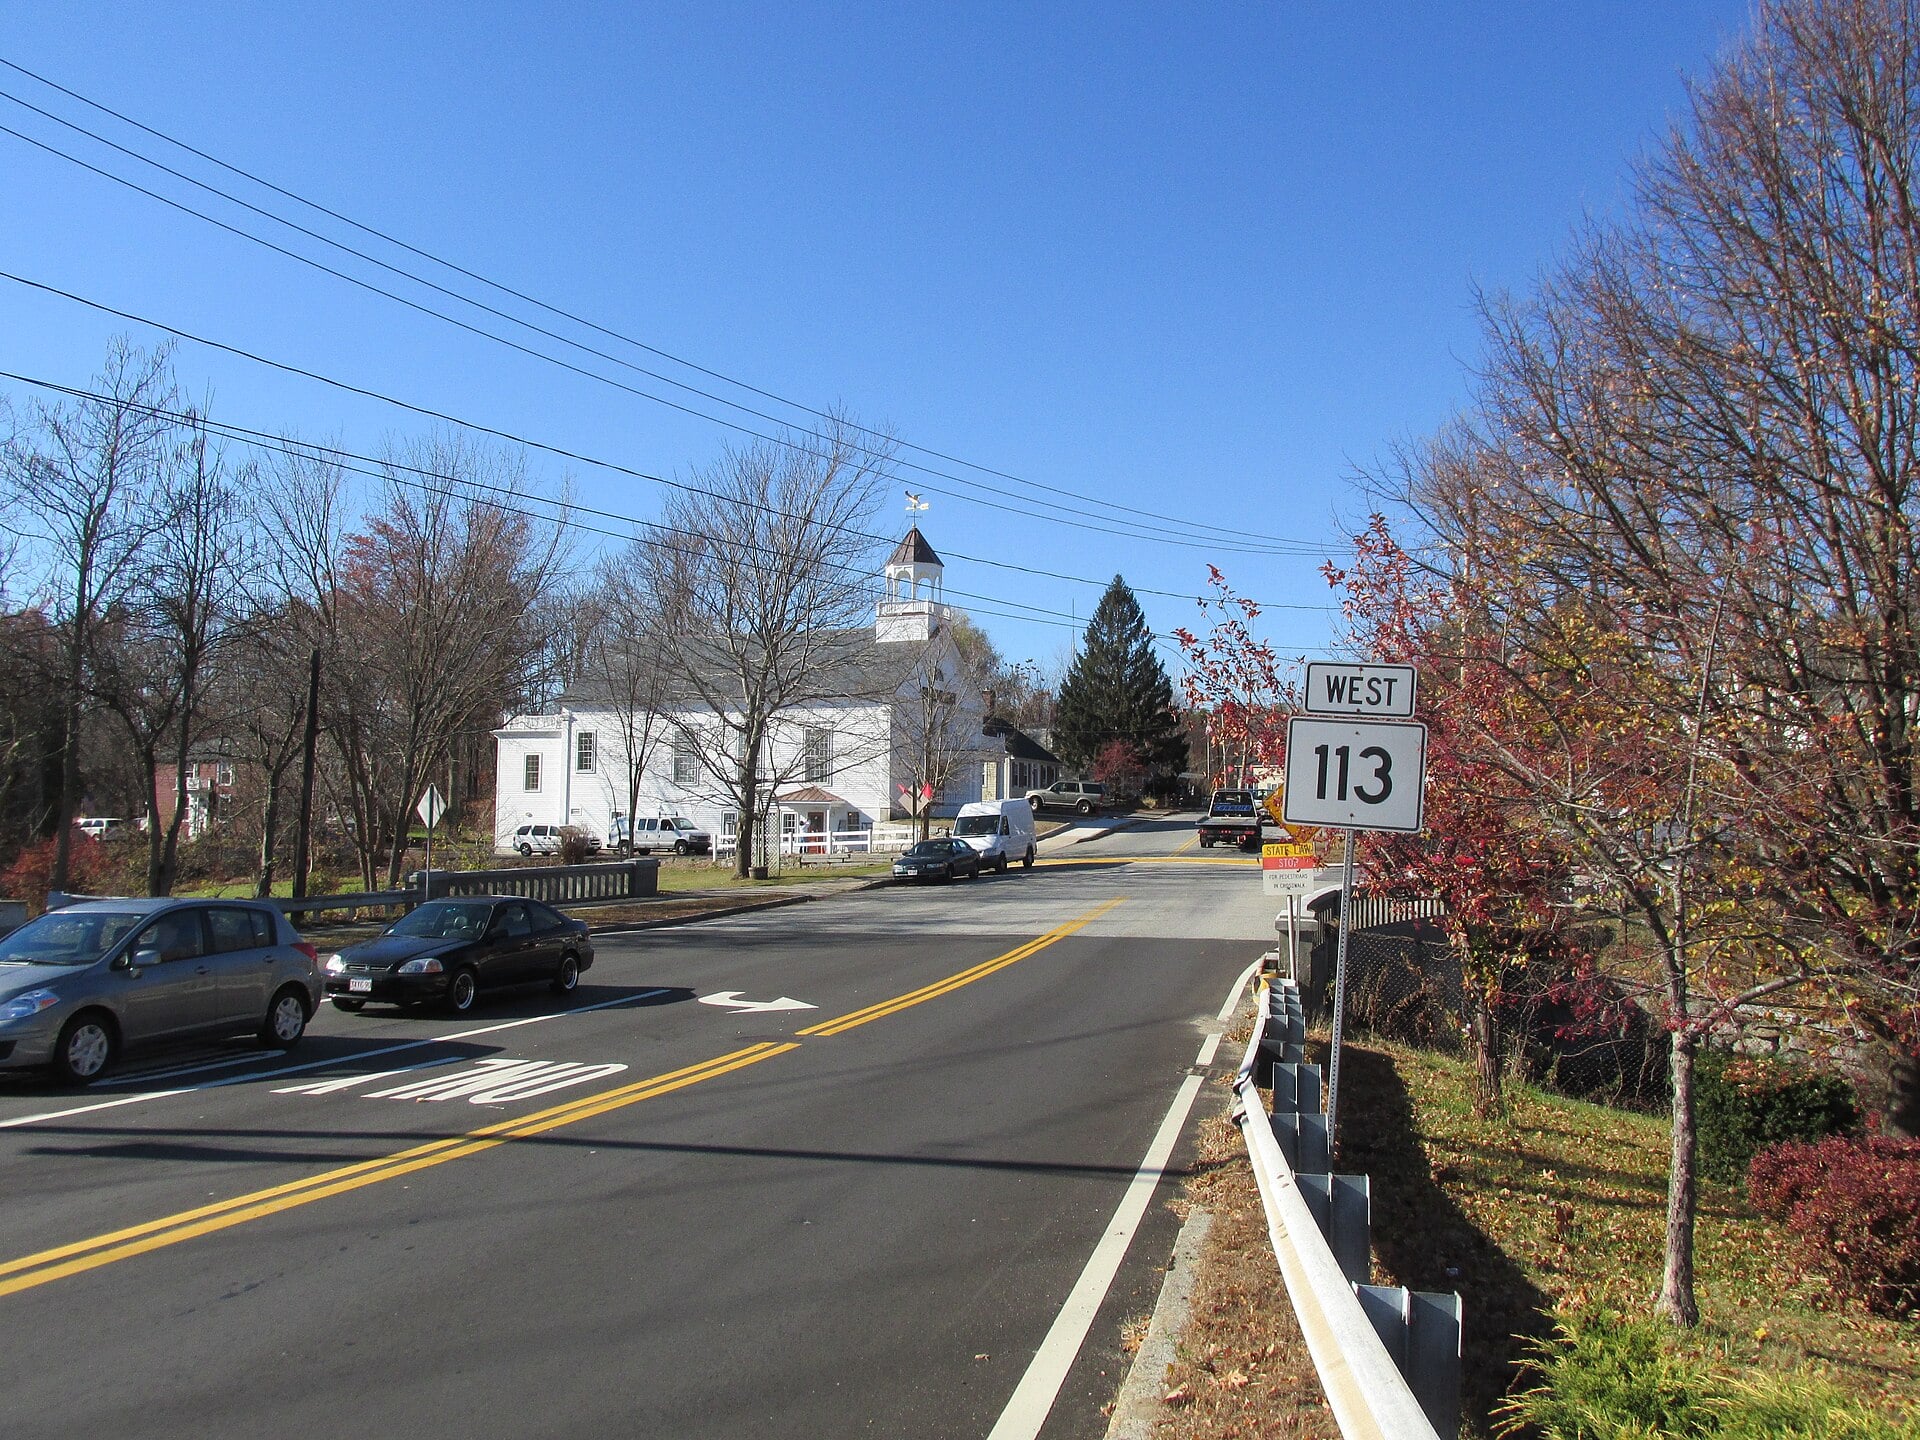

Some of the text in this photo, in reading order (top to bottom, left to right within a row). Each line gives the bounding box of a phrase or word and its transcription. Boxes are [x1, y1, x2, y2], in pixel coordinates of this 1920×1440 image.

[1326, 675, 1398, 706] WEST
[1314, 744, 1393, 804] 113
[1266, 845, 1289, 856] STATE
[1278, 858, 1299, 868] STOP
[269, 1056, 629, 1104] ONLY
